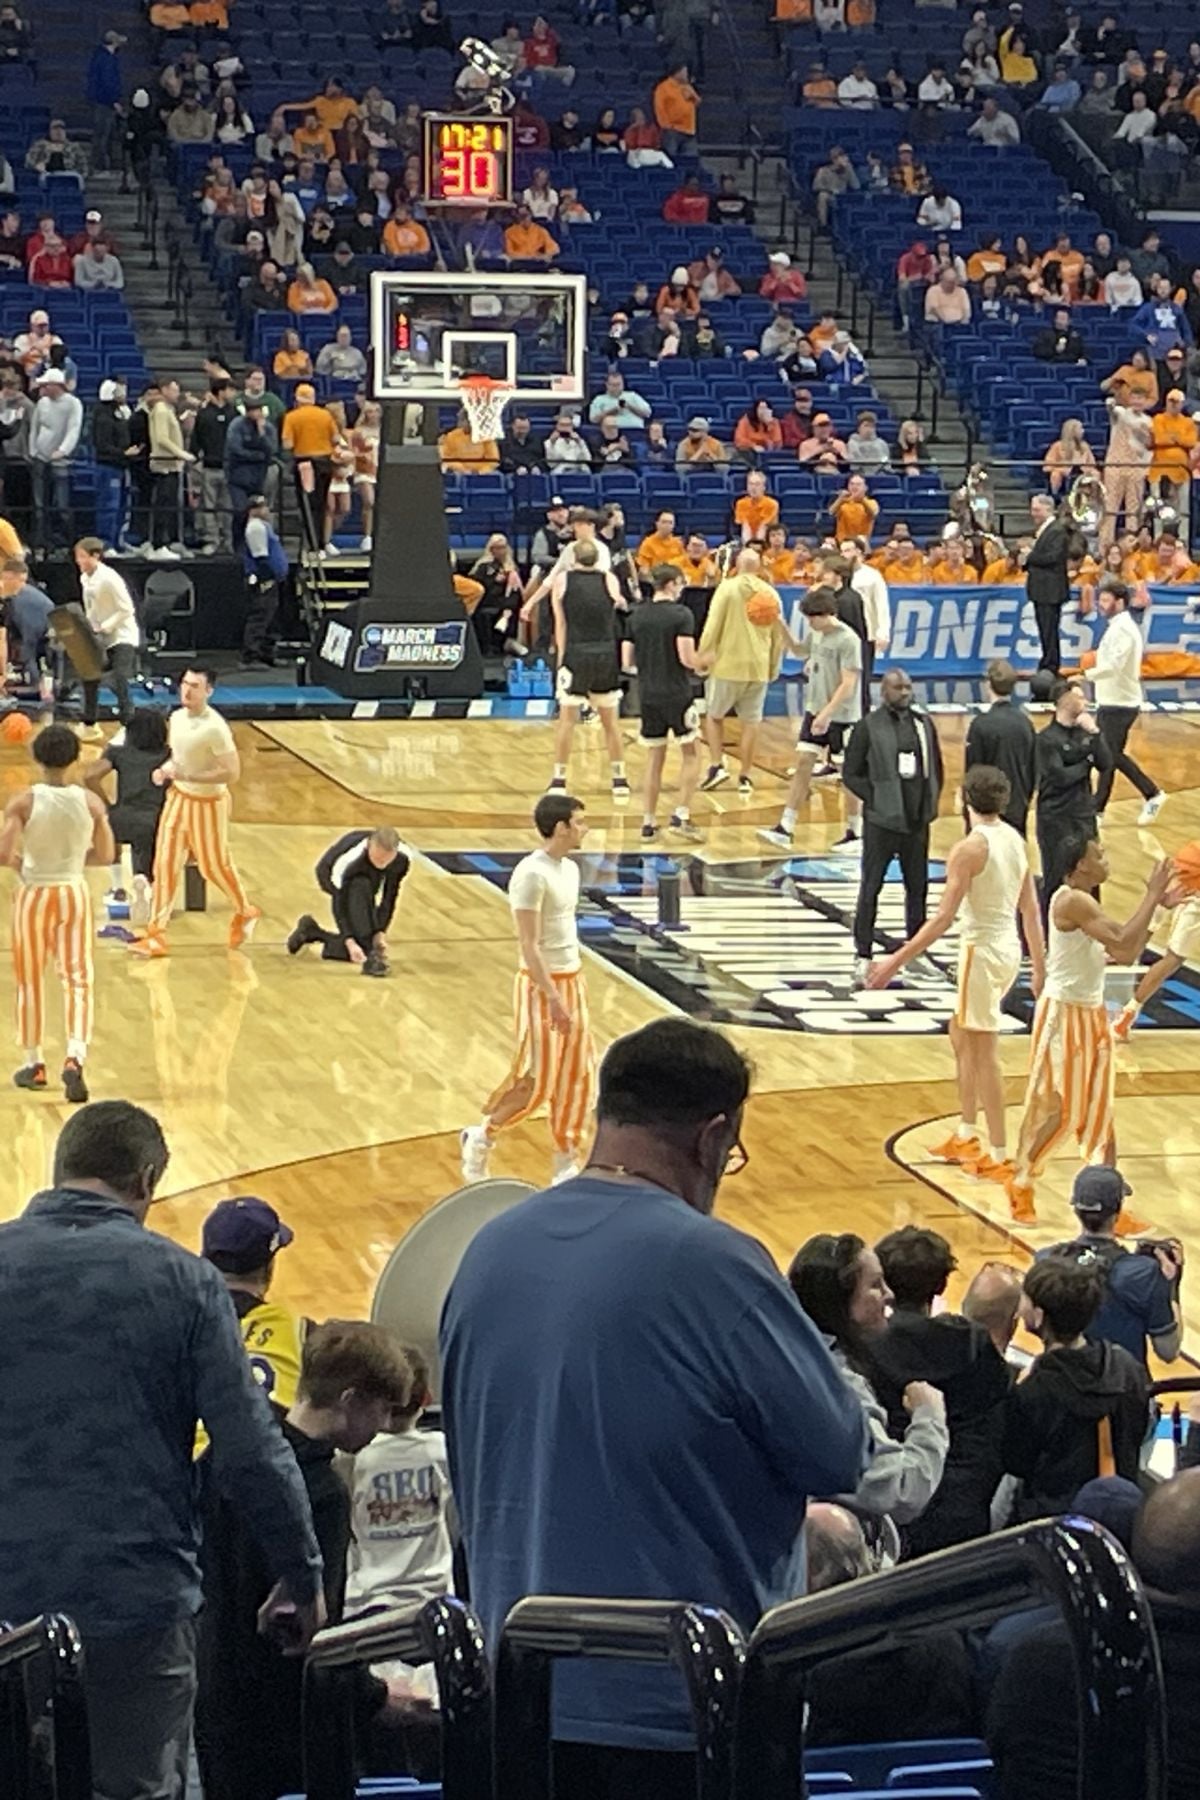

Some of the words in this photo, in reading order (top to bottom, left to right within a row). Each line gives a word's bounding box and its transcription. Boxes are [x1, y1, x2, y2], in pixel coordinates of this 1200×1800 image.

[442, 123, 503, 150] 17:21
[442, 151, 495, 195] 30
[381, 628, 436, 645] MARCH
[785, 600, 1098, 659] DNESS
[386, 645, 462, 662] MADNESS
